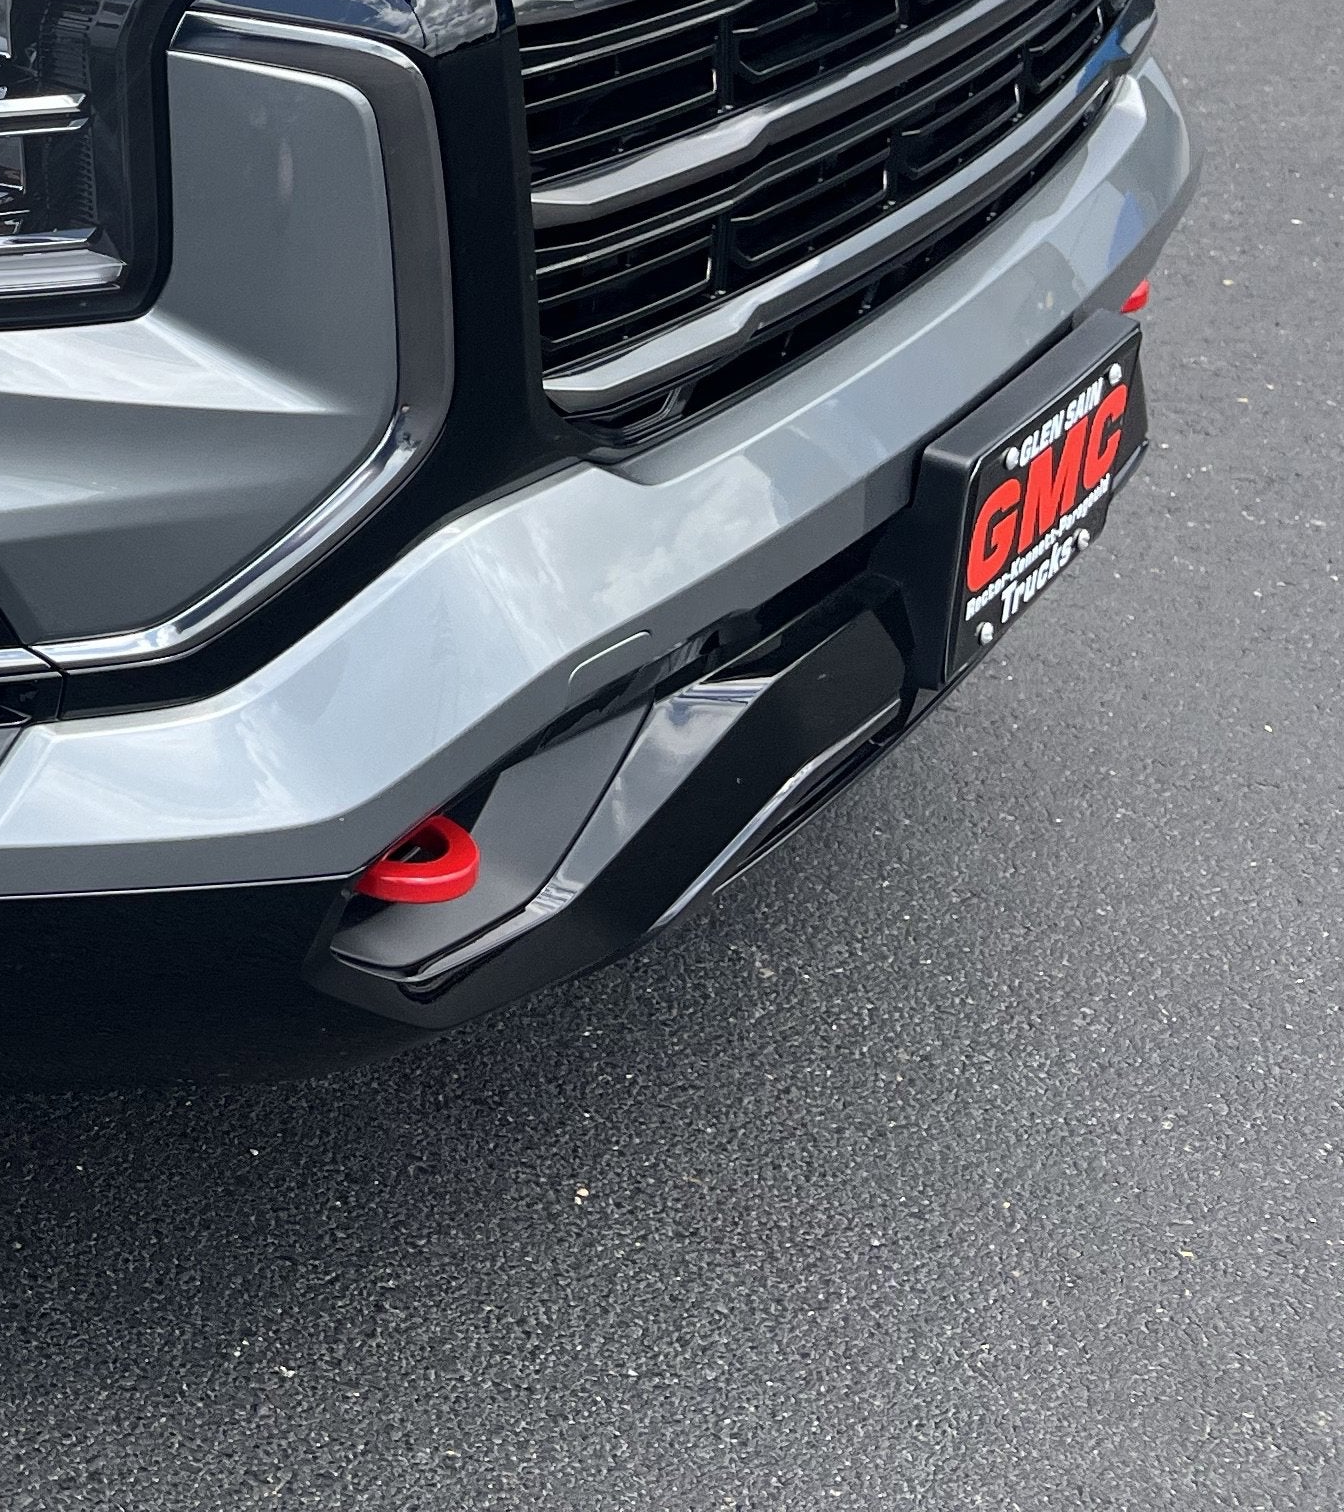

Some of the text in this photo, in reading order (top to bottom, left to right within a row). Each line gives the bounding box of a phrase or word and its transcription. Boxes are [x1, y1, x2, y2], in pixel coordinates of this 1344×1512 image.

[1018, 376, 1105, 468] GLEN SAIN
[967, 384, 1128, 591] GMC
[1000, 535, 1074, 624] Trucks
